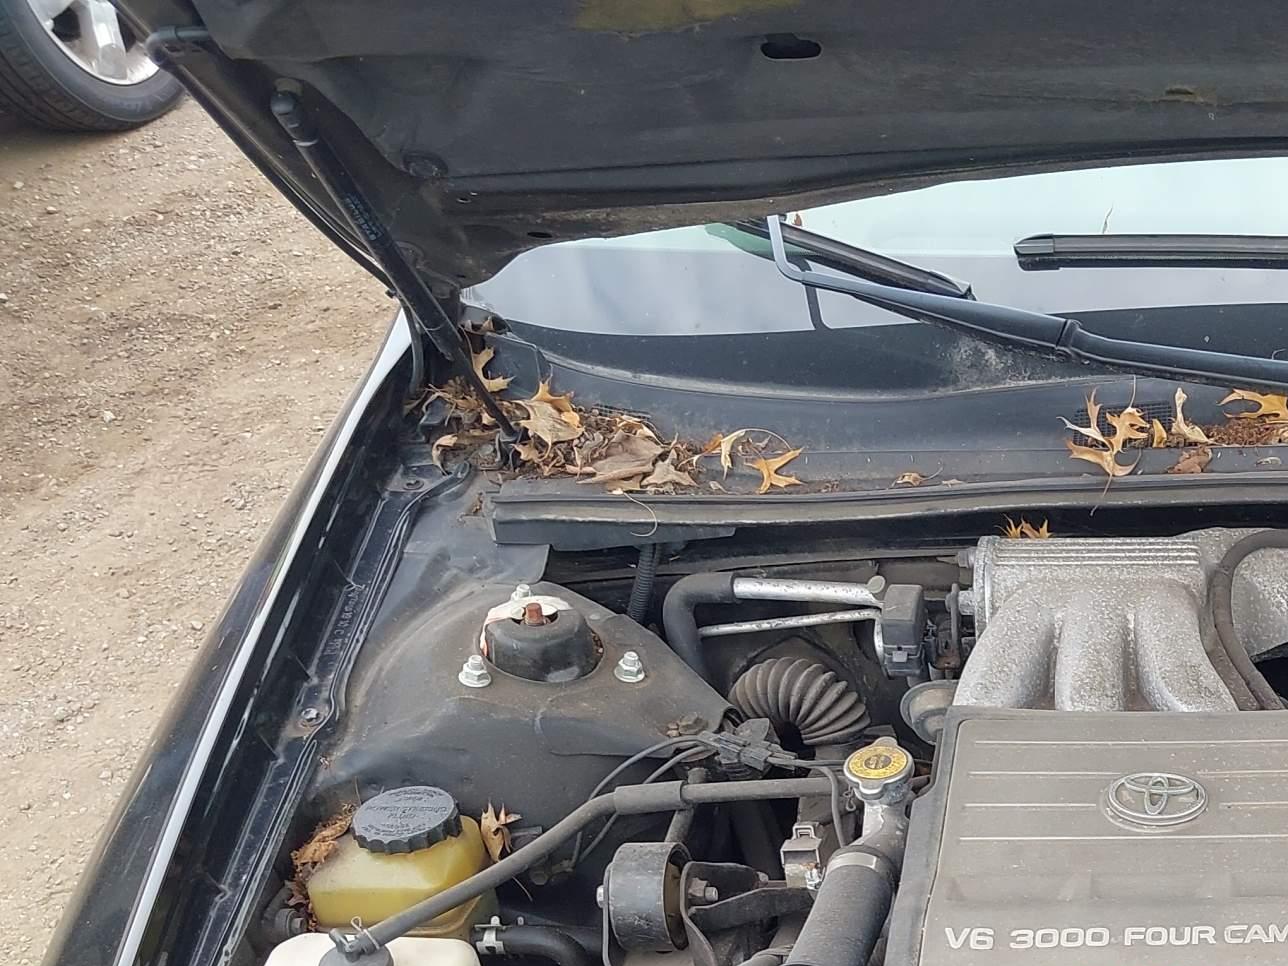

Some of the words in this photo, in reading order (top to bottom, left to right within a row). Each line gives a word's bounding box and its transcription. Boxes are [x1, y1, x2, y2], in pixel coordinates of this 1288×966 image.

[944, 927, 995, 950] V6
[1009, 927, 1110, 949] 3000
[1124, 926, 1216, 947] FOUR
